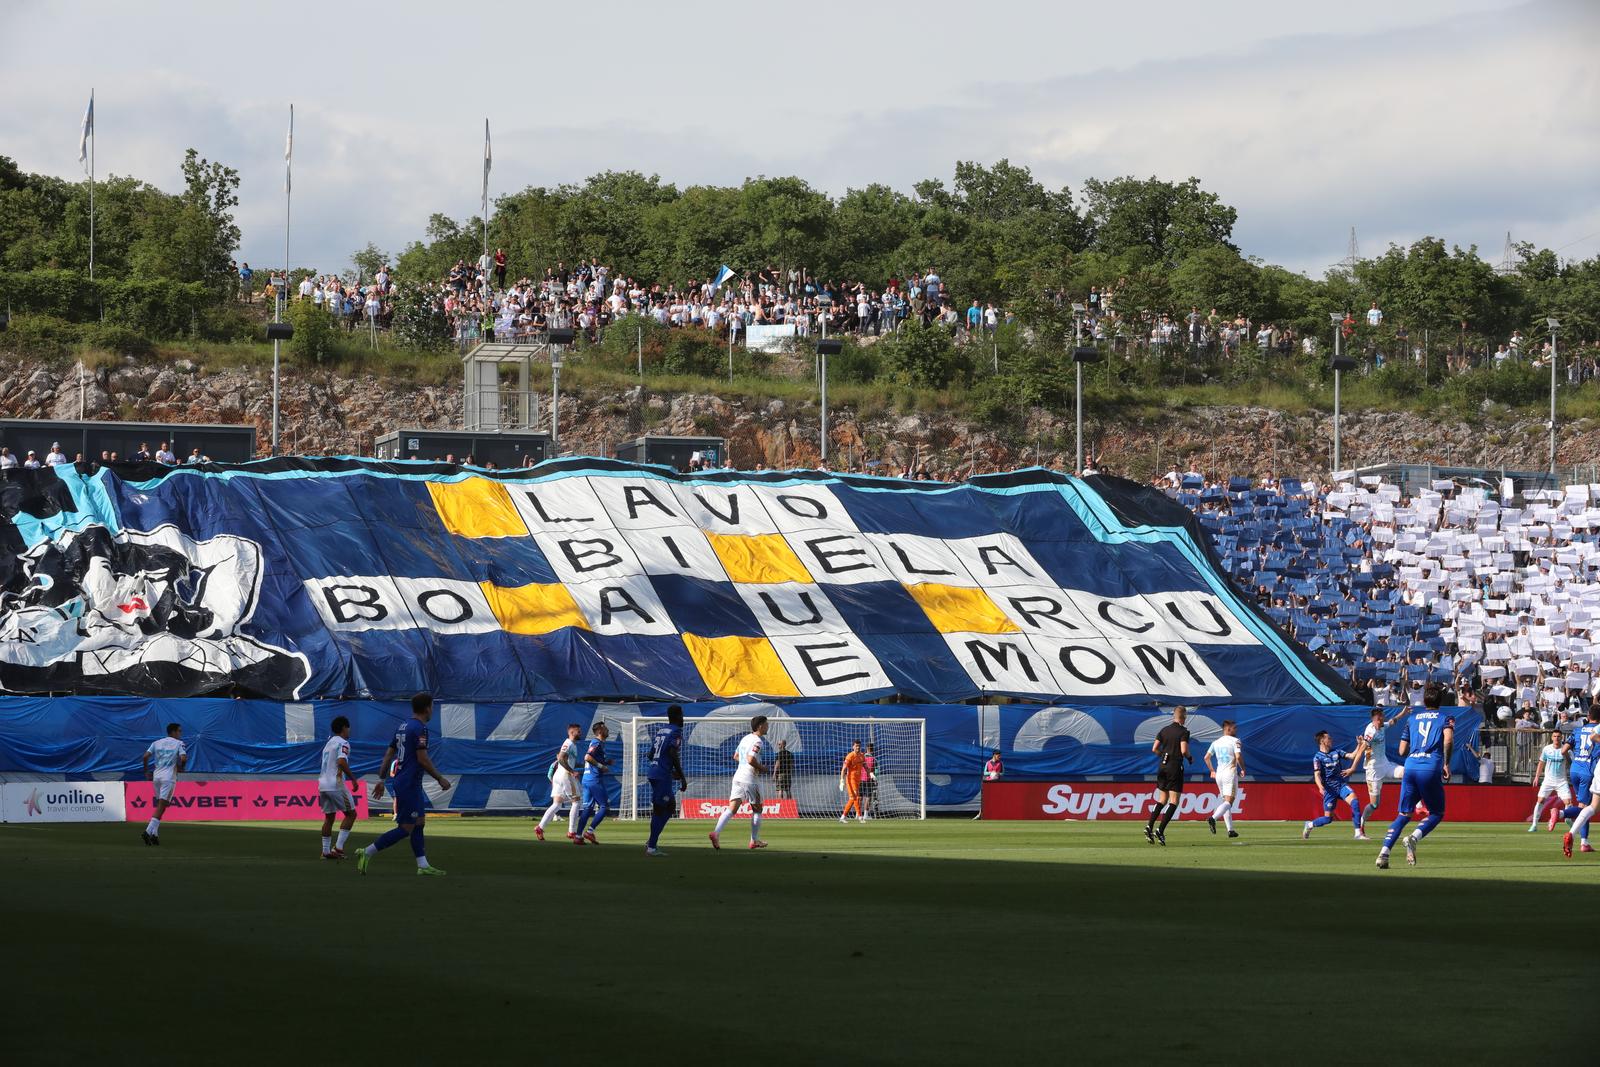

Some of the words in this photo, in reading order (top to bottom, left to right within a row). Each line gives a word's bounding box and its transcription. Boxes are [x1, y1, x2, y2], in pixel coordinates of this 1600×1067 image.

[525, 486, 828, 524] LAVO
[964, 639, 1206, 687] MOM
[1418, 720, 1432, 748] 4
[46, 789, 105, 804] uniline
[274, 795, 363, 807] FAVT
